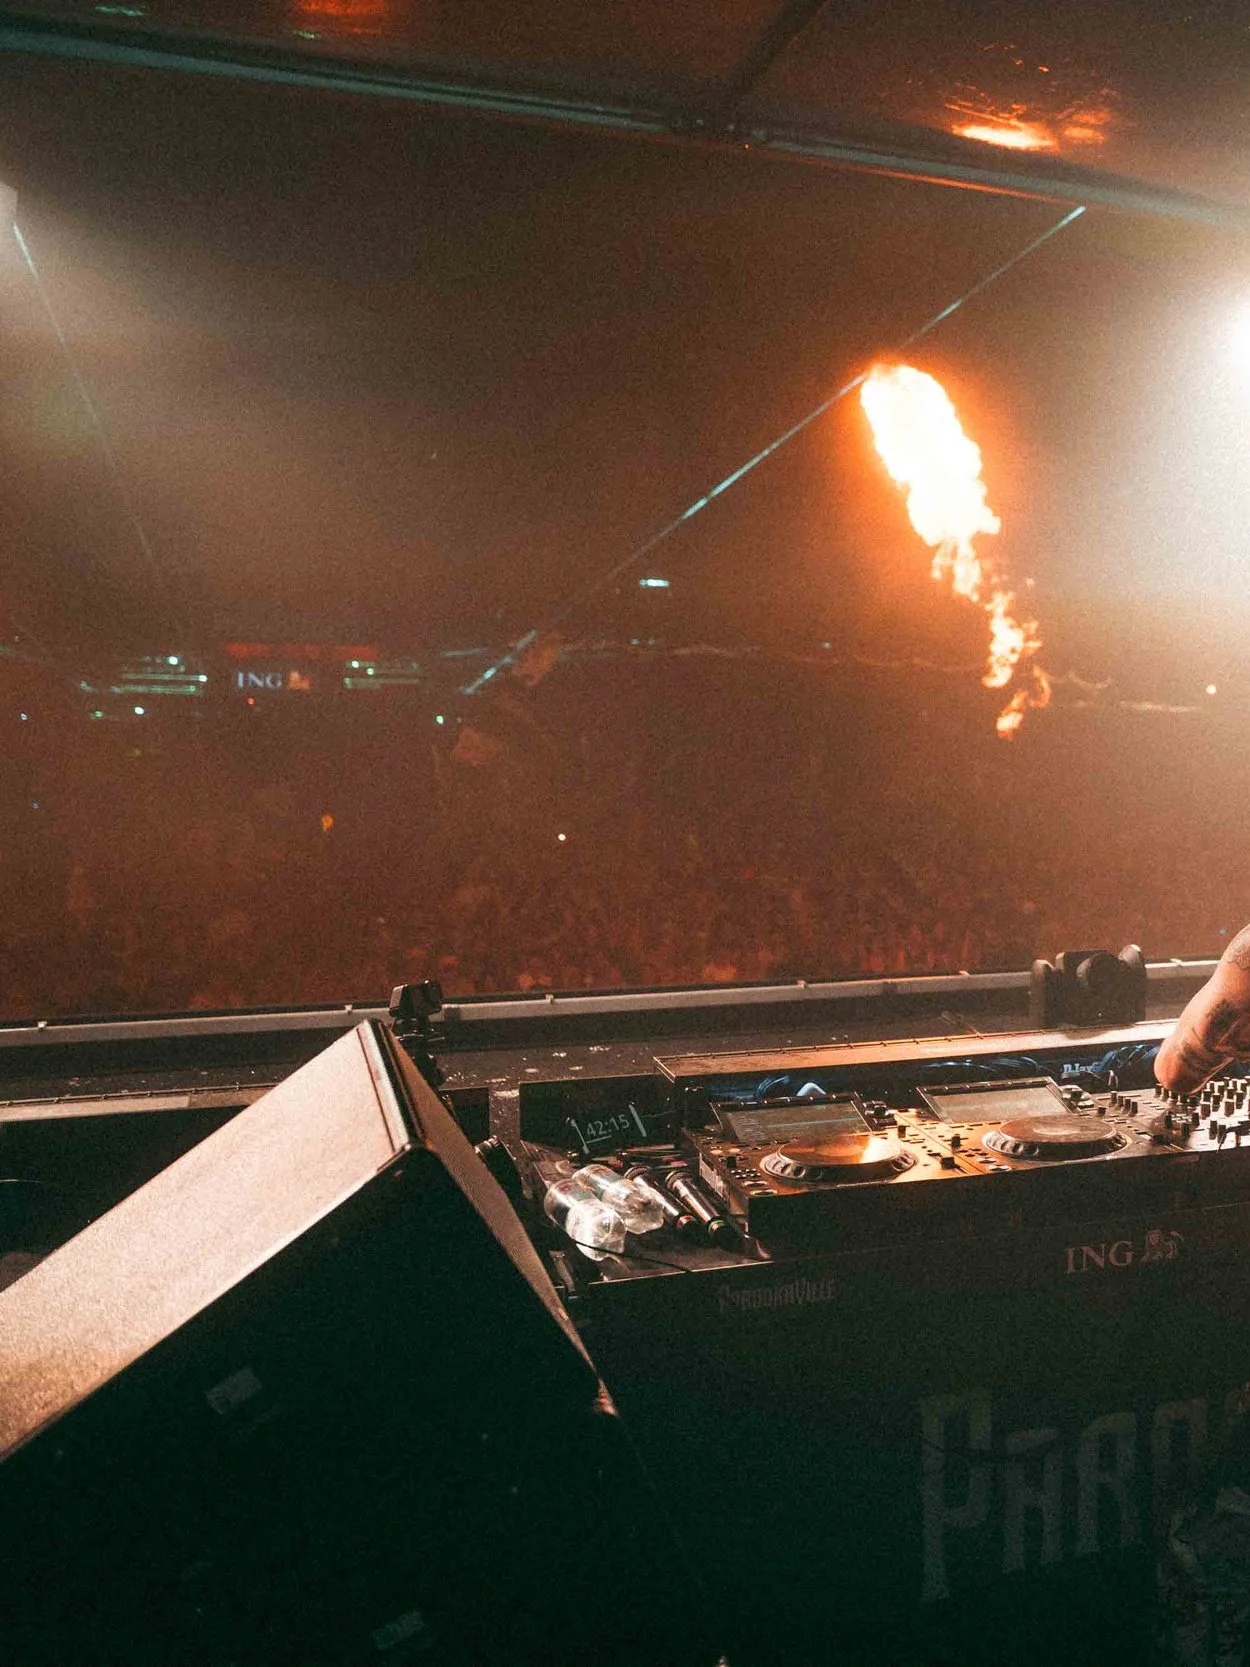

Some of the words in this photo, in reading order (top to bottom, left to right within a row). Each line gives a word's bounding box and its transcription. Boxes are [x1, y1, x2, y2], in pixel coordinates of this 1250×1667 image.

[236, 671, 282, 690] ING
[586, 1114, 630, 1137] 42:15
[1065, 1240, 1134, 1274] ING
